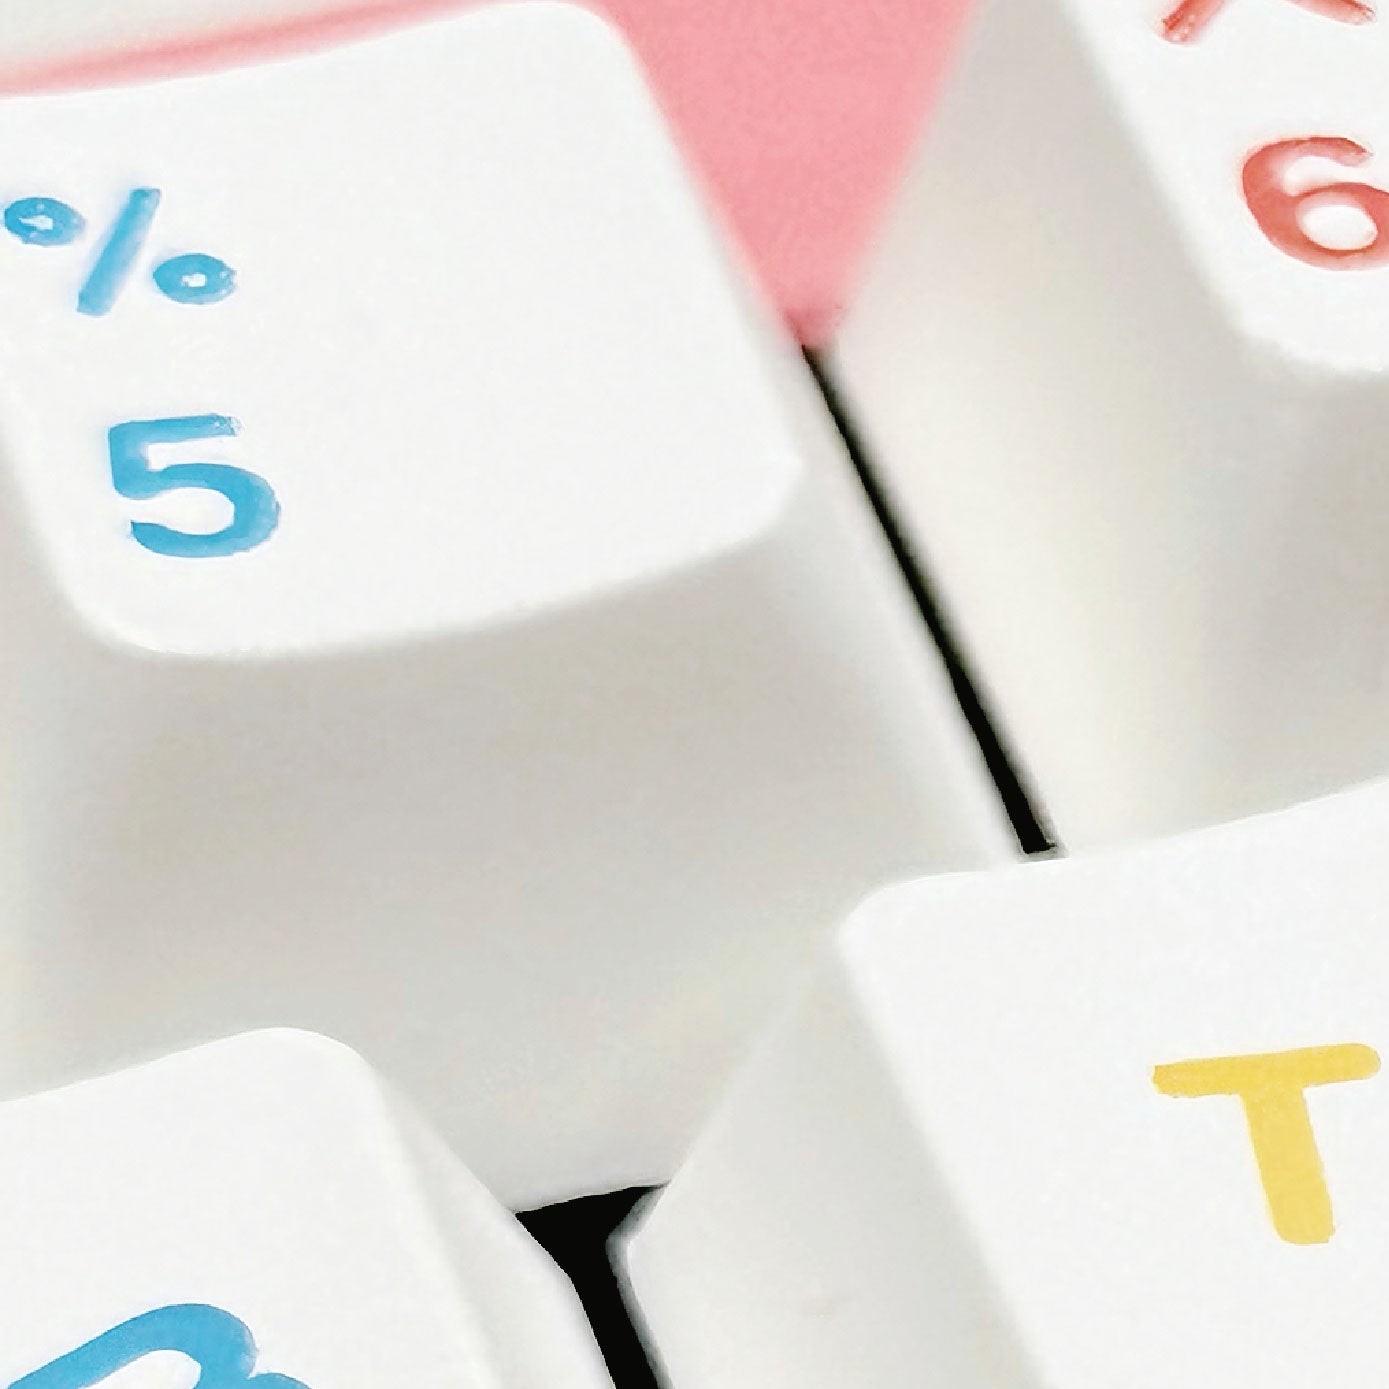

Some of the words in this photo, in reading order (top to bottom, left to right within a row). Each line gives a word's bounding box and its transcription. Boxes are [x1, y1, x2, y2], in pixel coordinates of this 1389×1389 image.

[0, 186, 240, 318] %
[106, 412, 282, 559] 5
[1150, 1040, 1382, 1247] T
